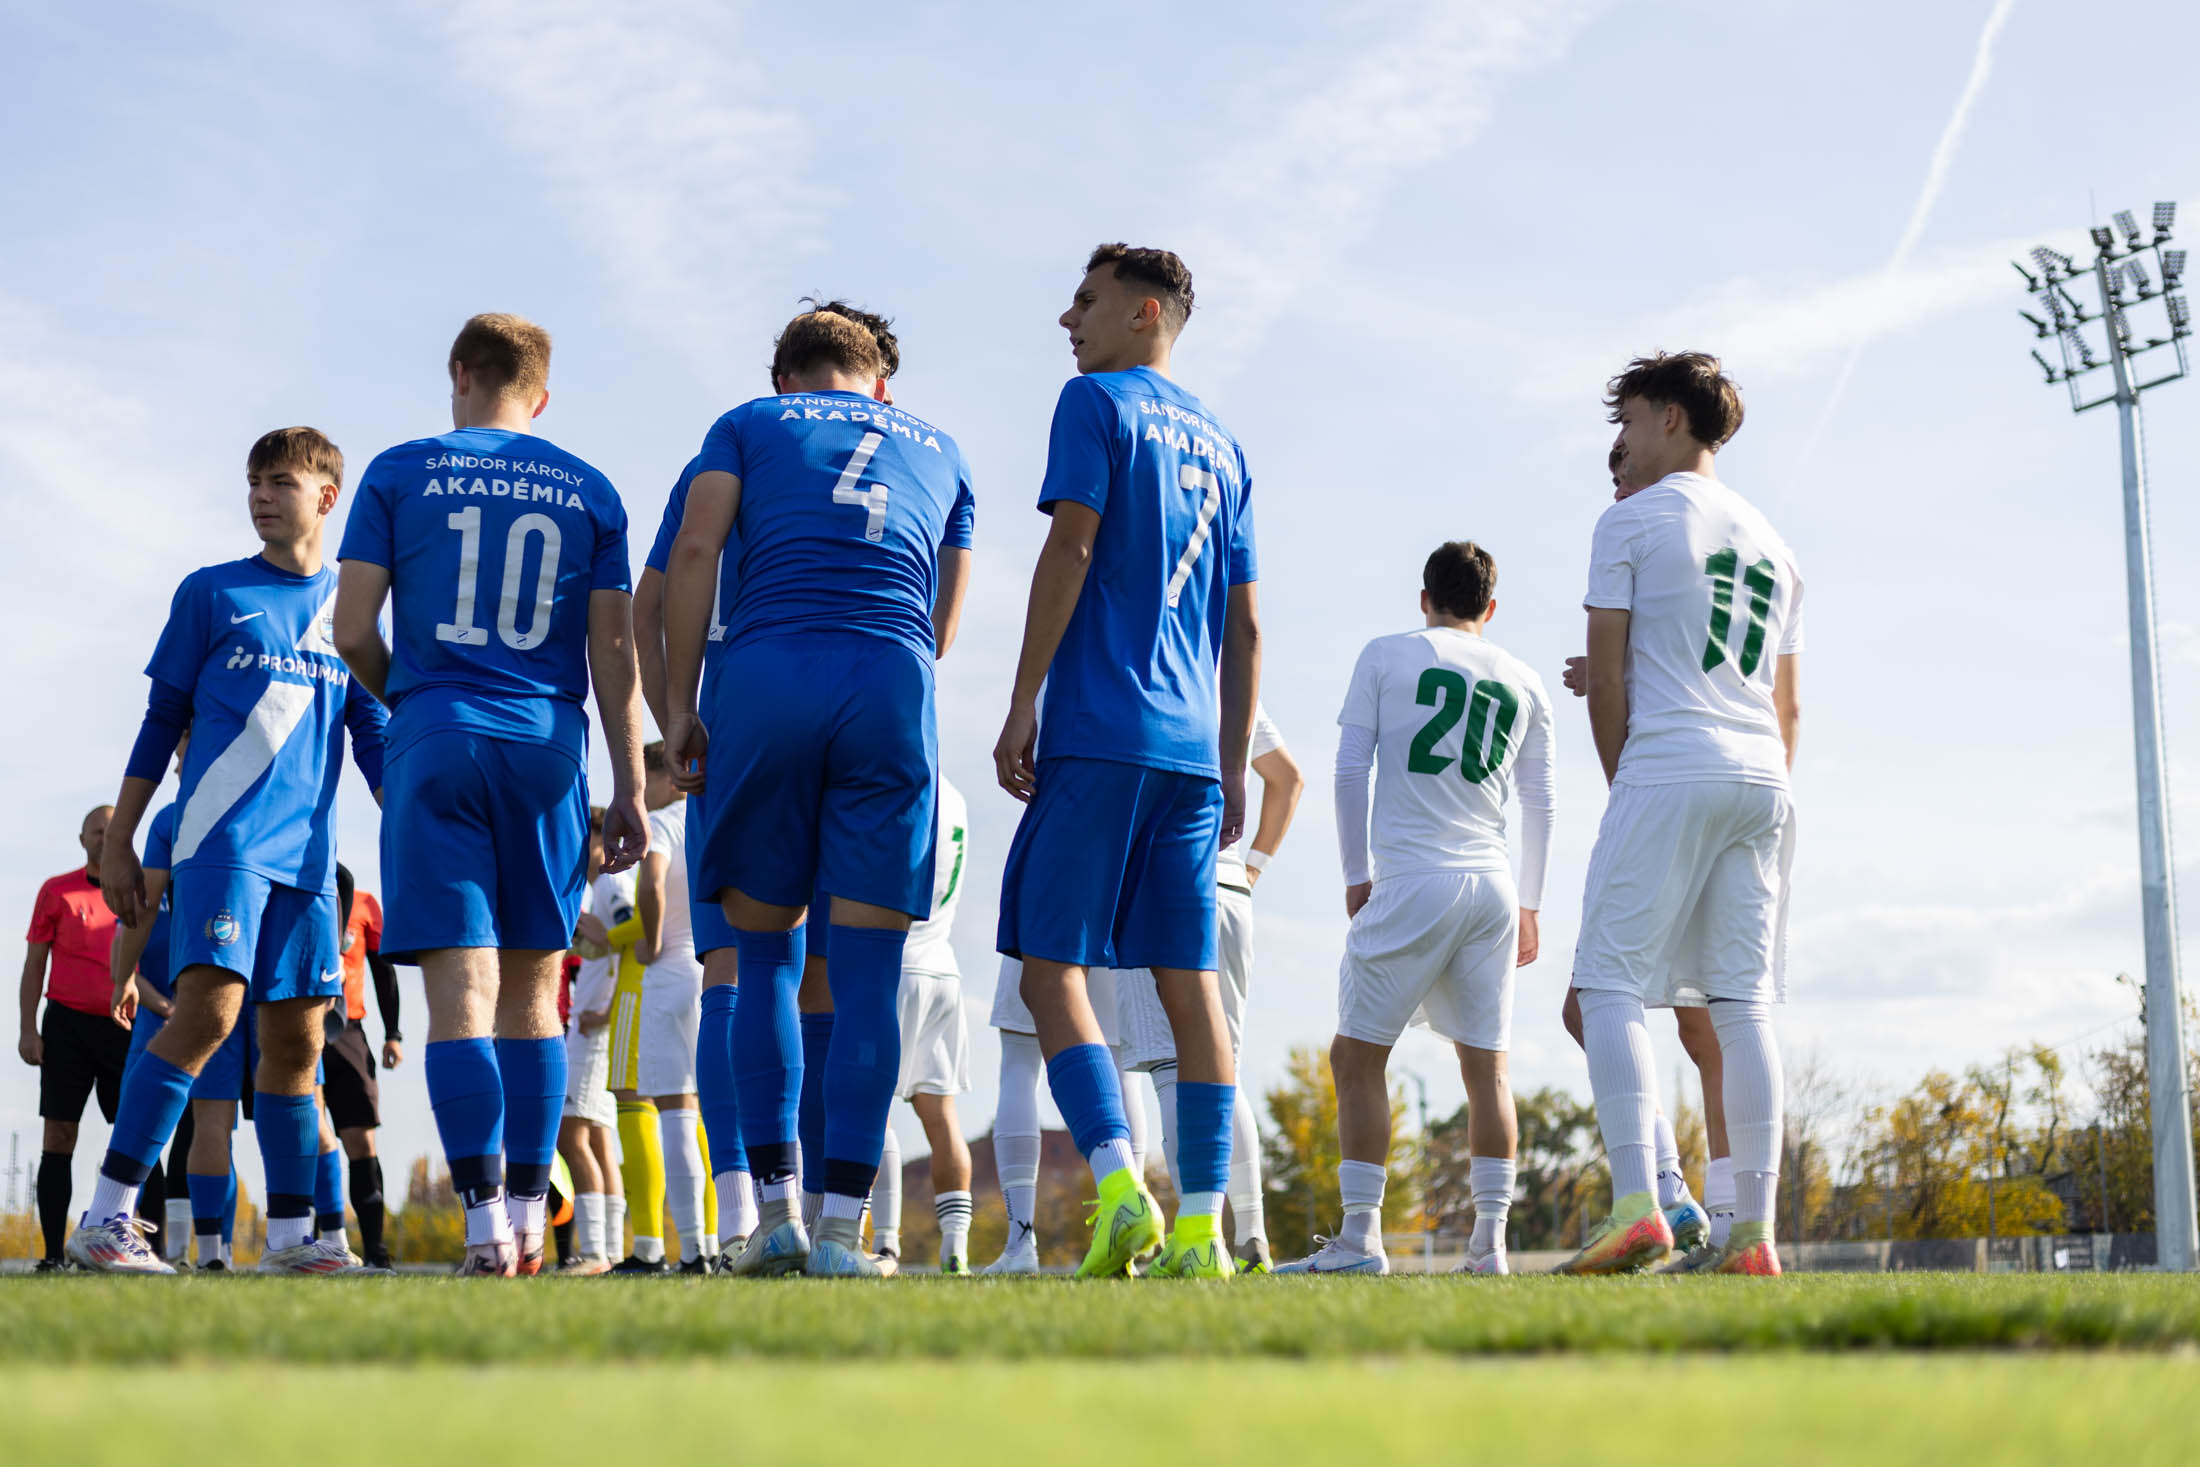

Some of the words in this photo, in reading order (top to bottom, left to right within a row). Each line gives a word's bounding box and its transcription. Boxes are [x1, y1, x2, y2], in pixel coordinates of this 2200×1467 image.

[425, 453, 507, 471] SÁNDOR
[513, 460, 584, 487] KÁROLY
[779, 408, 942, 453] AKADÉMIA
[423, 477, 585, 511] AKADÉMIA
[832, 432, 888, 543] 4
[1168, 464, 1220, 608] 7
[435, 506, 562, 650] 10
[1702, 546, 1775, 678] 11
[258, 654, 349, 688] PROHUMAN
[1408, 667, 1519, 784] 20
